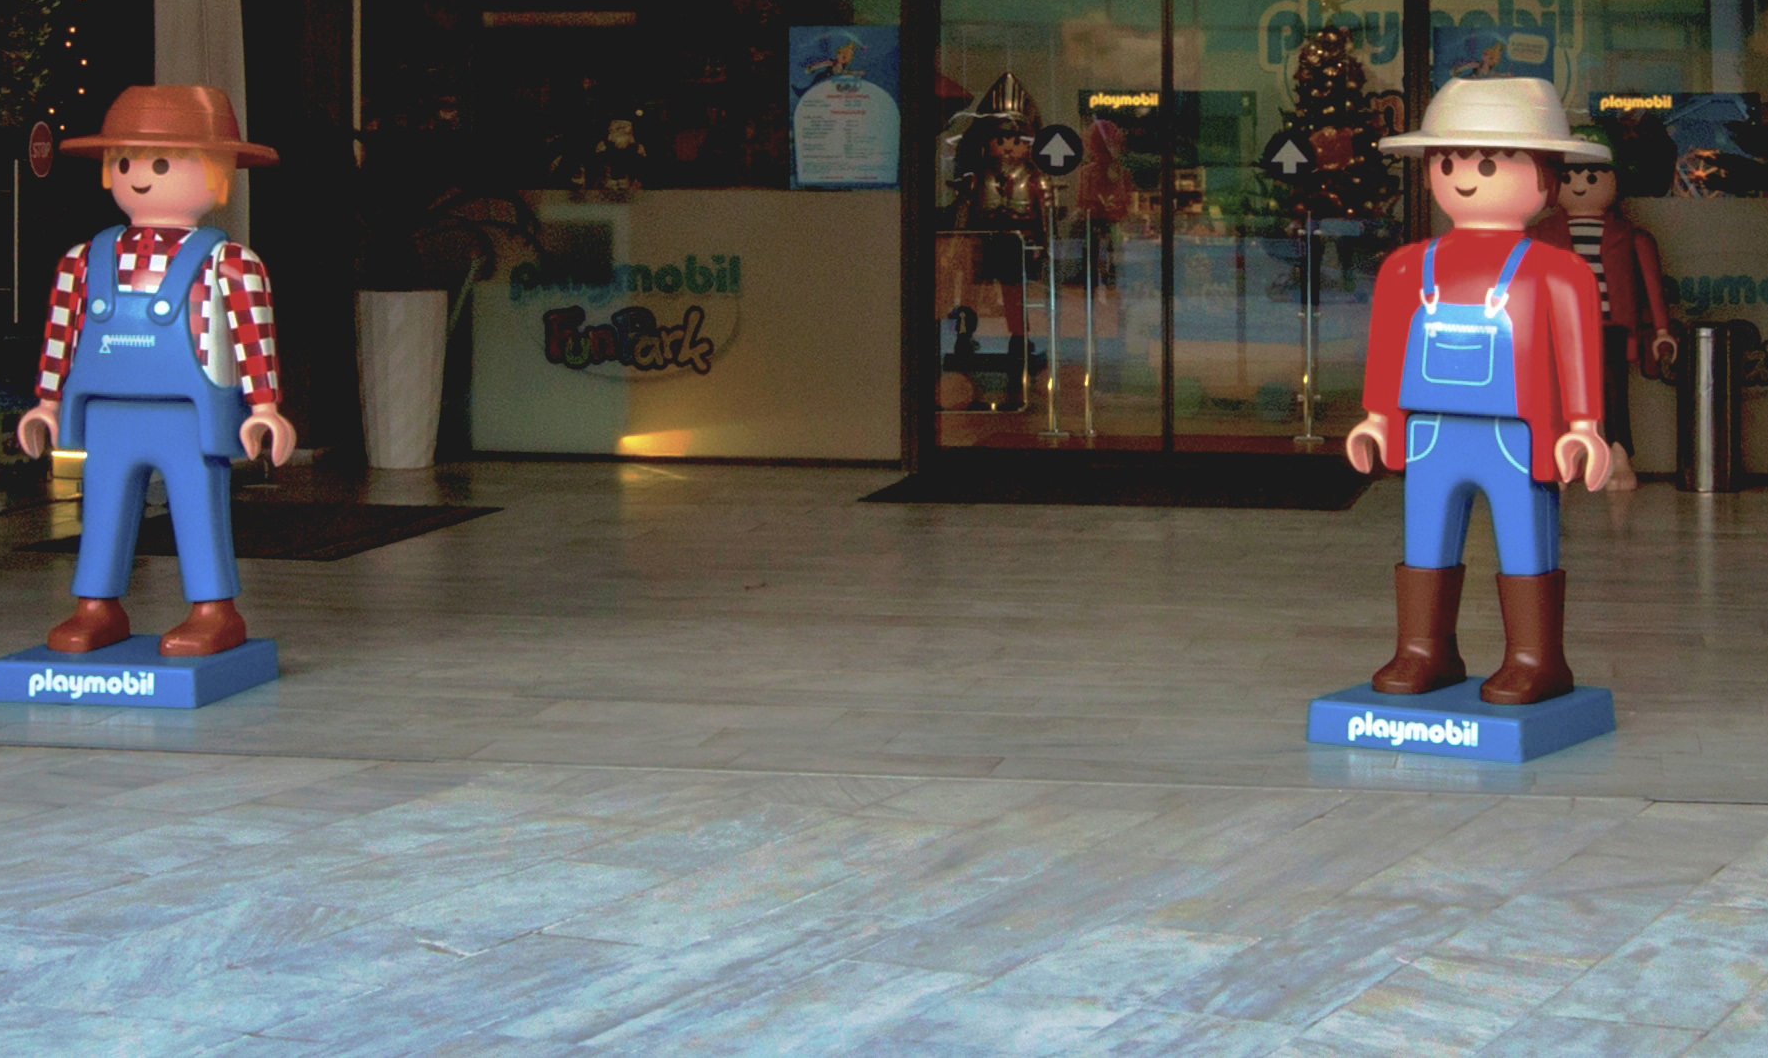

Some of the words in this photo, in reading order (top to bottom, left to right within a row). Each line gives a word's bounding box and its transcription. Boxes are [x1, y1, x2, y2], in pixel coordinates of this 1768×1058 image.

[1089, 92, 1159, 110] playmobil
[1599, 94, 1673, 111] playmobil
[28, 668, 155, 699] playmobil
[1347, 711, 1479, 747] playmobil
